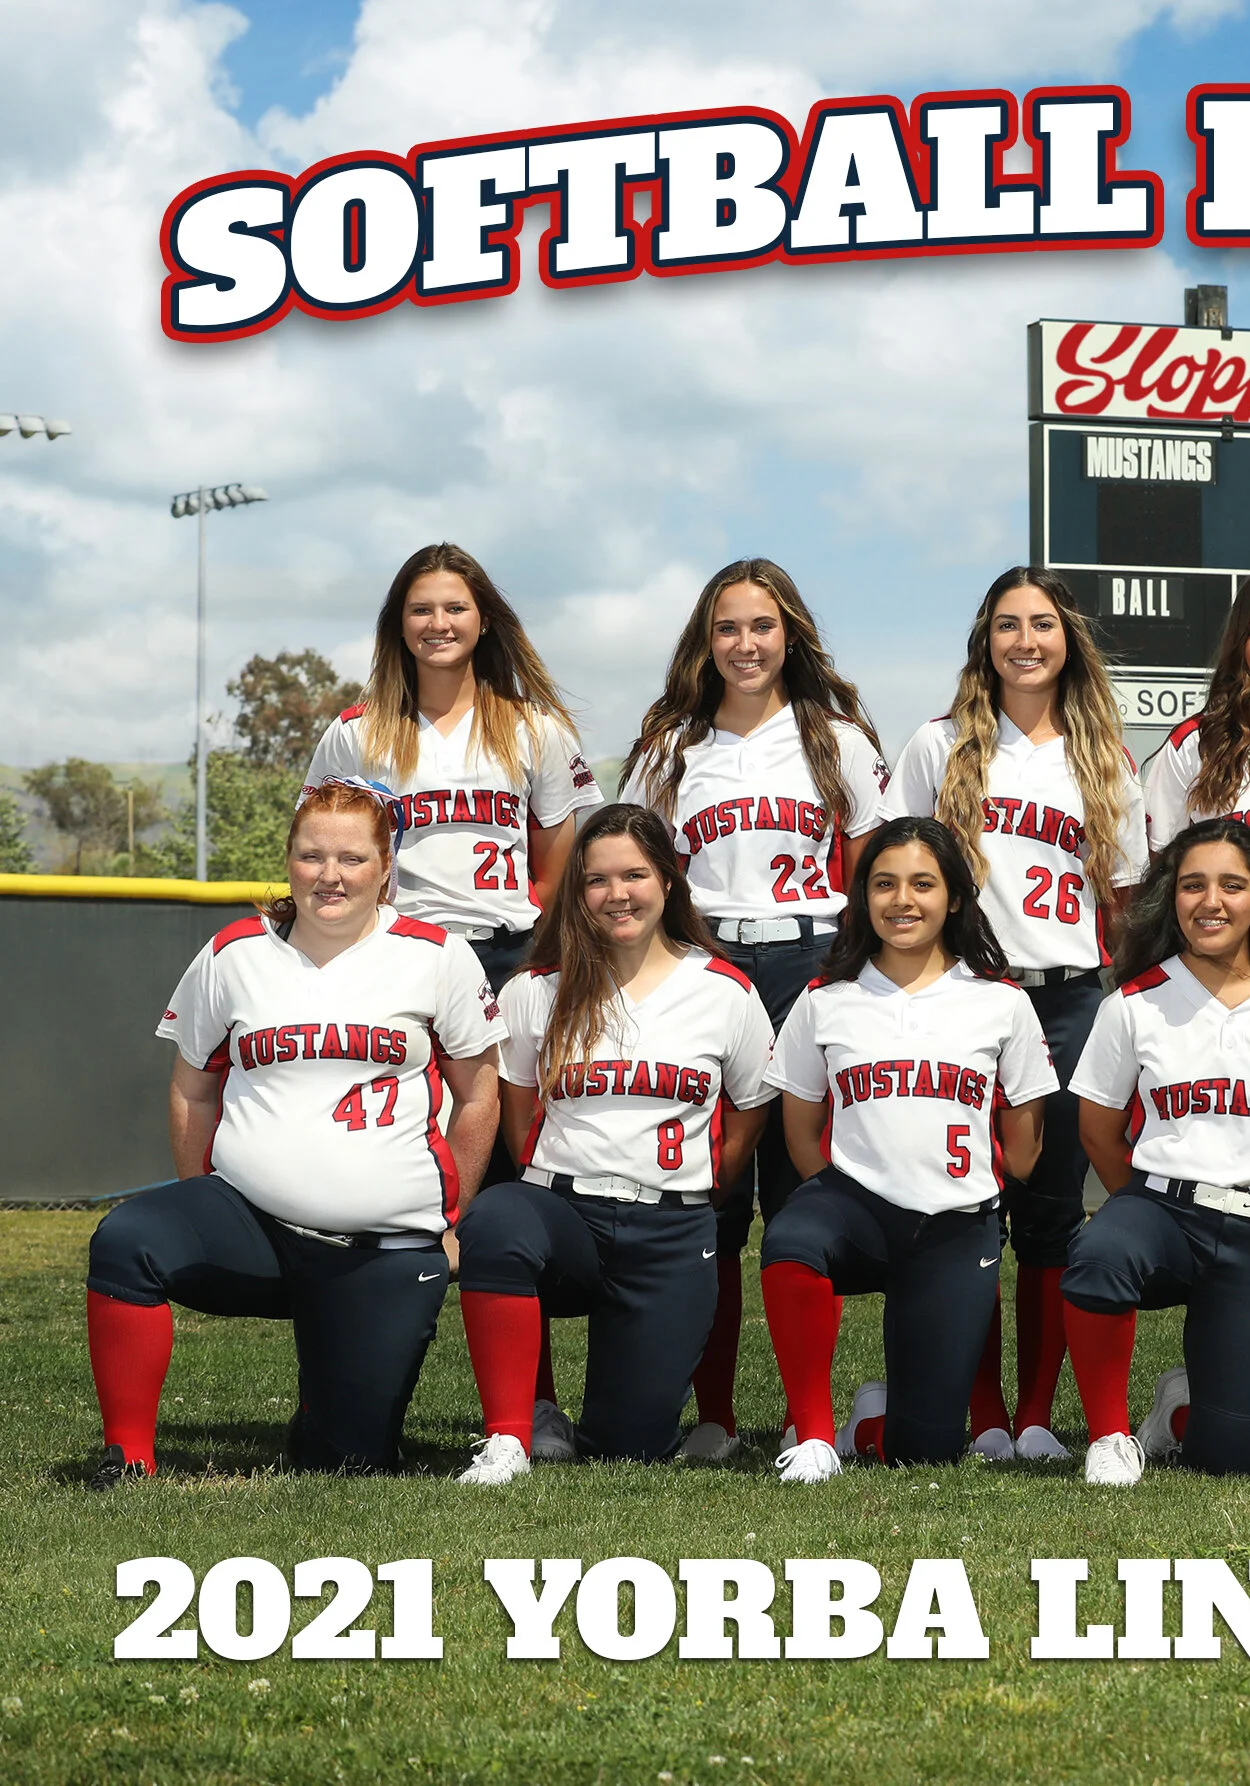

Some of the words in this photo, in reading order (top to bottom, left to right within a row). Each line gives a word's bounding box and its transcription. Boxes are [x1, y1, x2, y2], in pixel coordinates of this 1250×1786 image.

[1086, 436, 1212, 482] MUSTANGS
[1112, 577, 1170, 617] BALL
[1137, 689, 1208, 717] SOF
[682, 796, 827, 855] MUSTANGS
[473, 840, 519, 890] 21
[770, 853, 830, 903] 22
[1023, 865, 1084, 925] 26
[238, 1023, 407, 1071] MUSTANGS
[332, 1075, 399, 1132] 47
[835, 1060, 988, 1111] MUSTANGS
[656, 1118, 685, 1171] 8
[946, 1124, 971, 1178] 5
